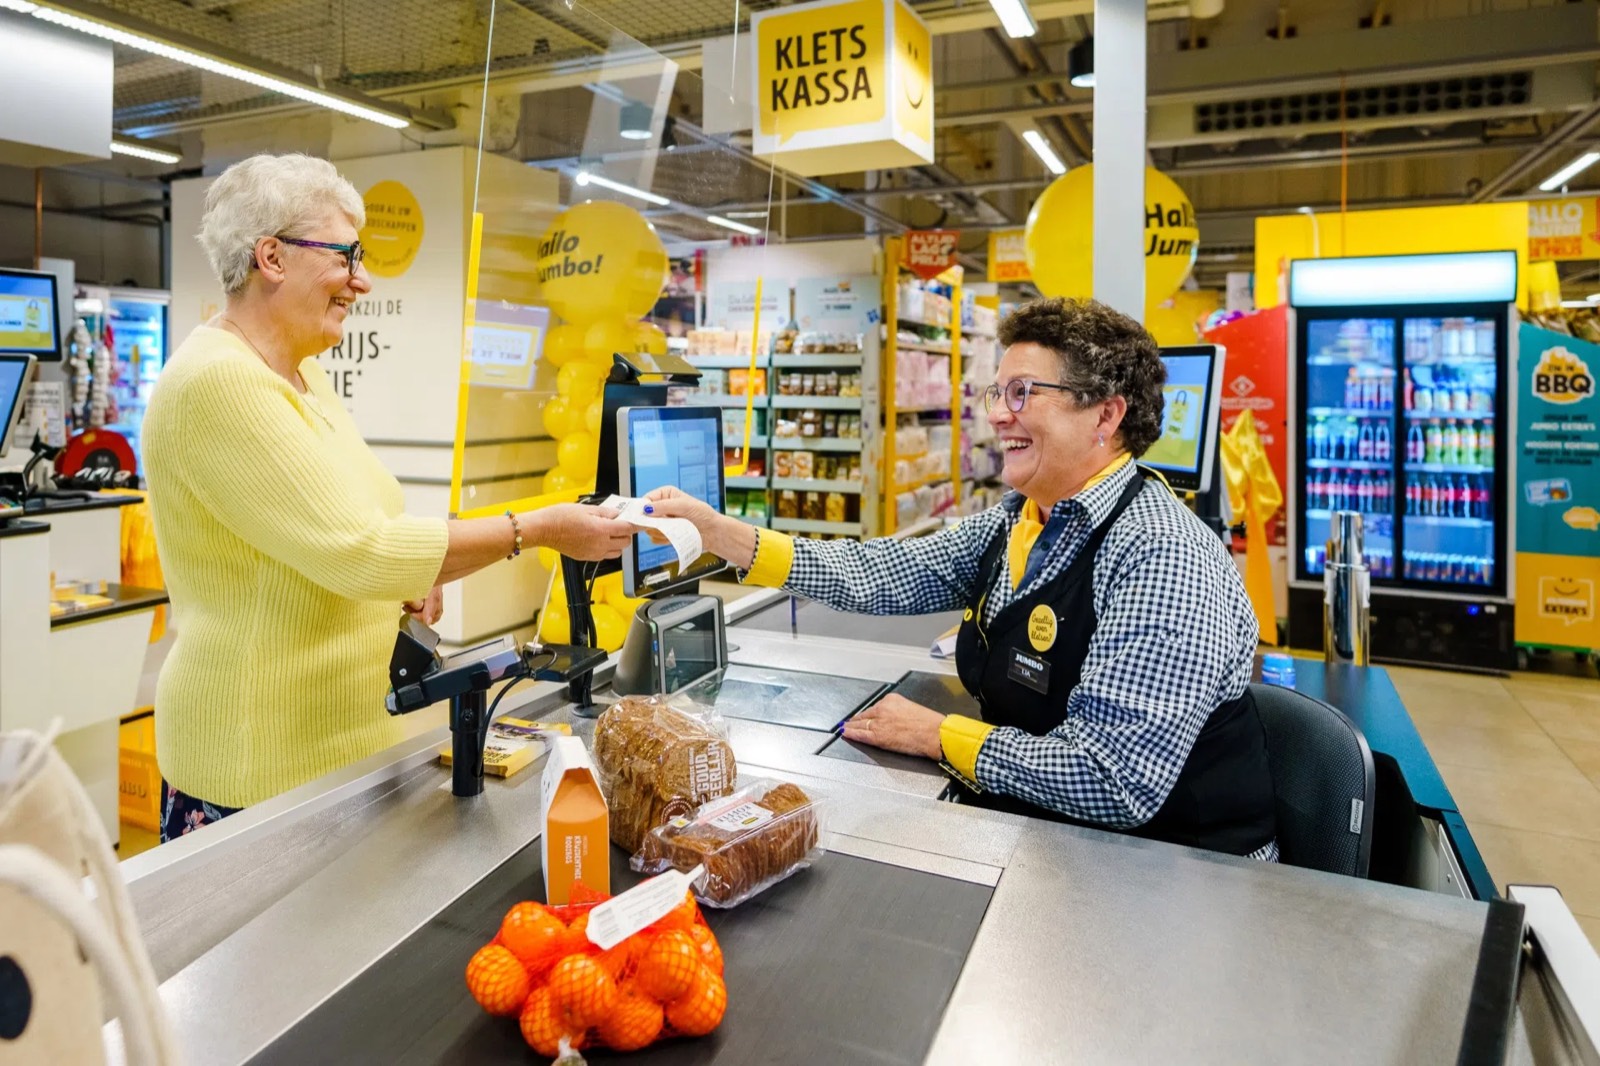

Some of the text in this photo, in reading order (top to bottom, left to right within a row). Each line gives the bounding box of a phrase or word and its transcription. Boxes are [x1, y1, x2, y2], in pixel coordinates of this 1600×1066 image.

[775, 24, 867, 71] KLETS
[771, 66, 872, 112] KASSA
[1528, 203, 1583, 223] ALLO
[537, 231, 579, 259] allo
[538, 255, 603, 283] umbo!
[387, 300, 402, 315] DE
[315, 331, 391, 363] RIJS-
[1536, 374, 1591, 394] BBQ
[1544, 604, 1588, 615] EXTRA'S
[1016, 654, 1043, 671] JUMBO
[695, 753, 710, 792] GOUD
